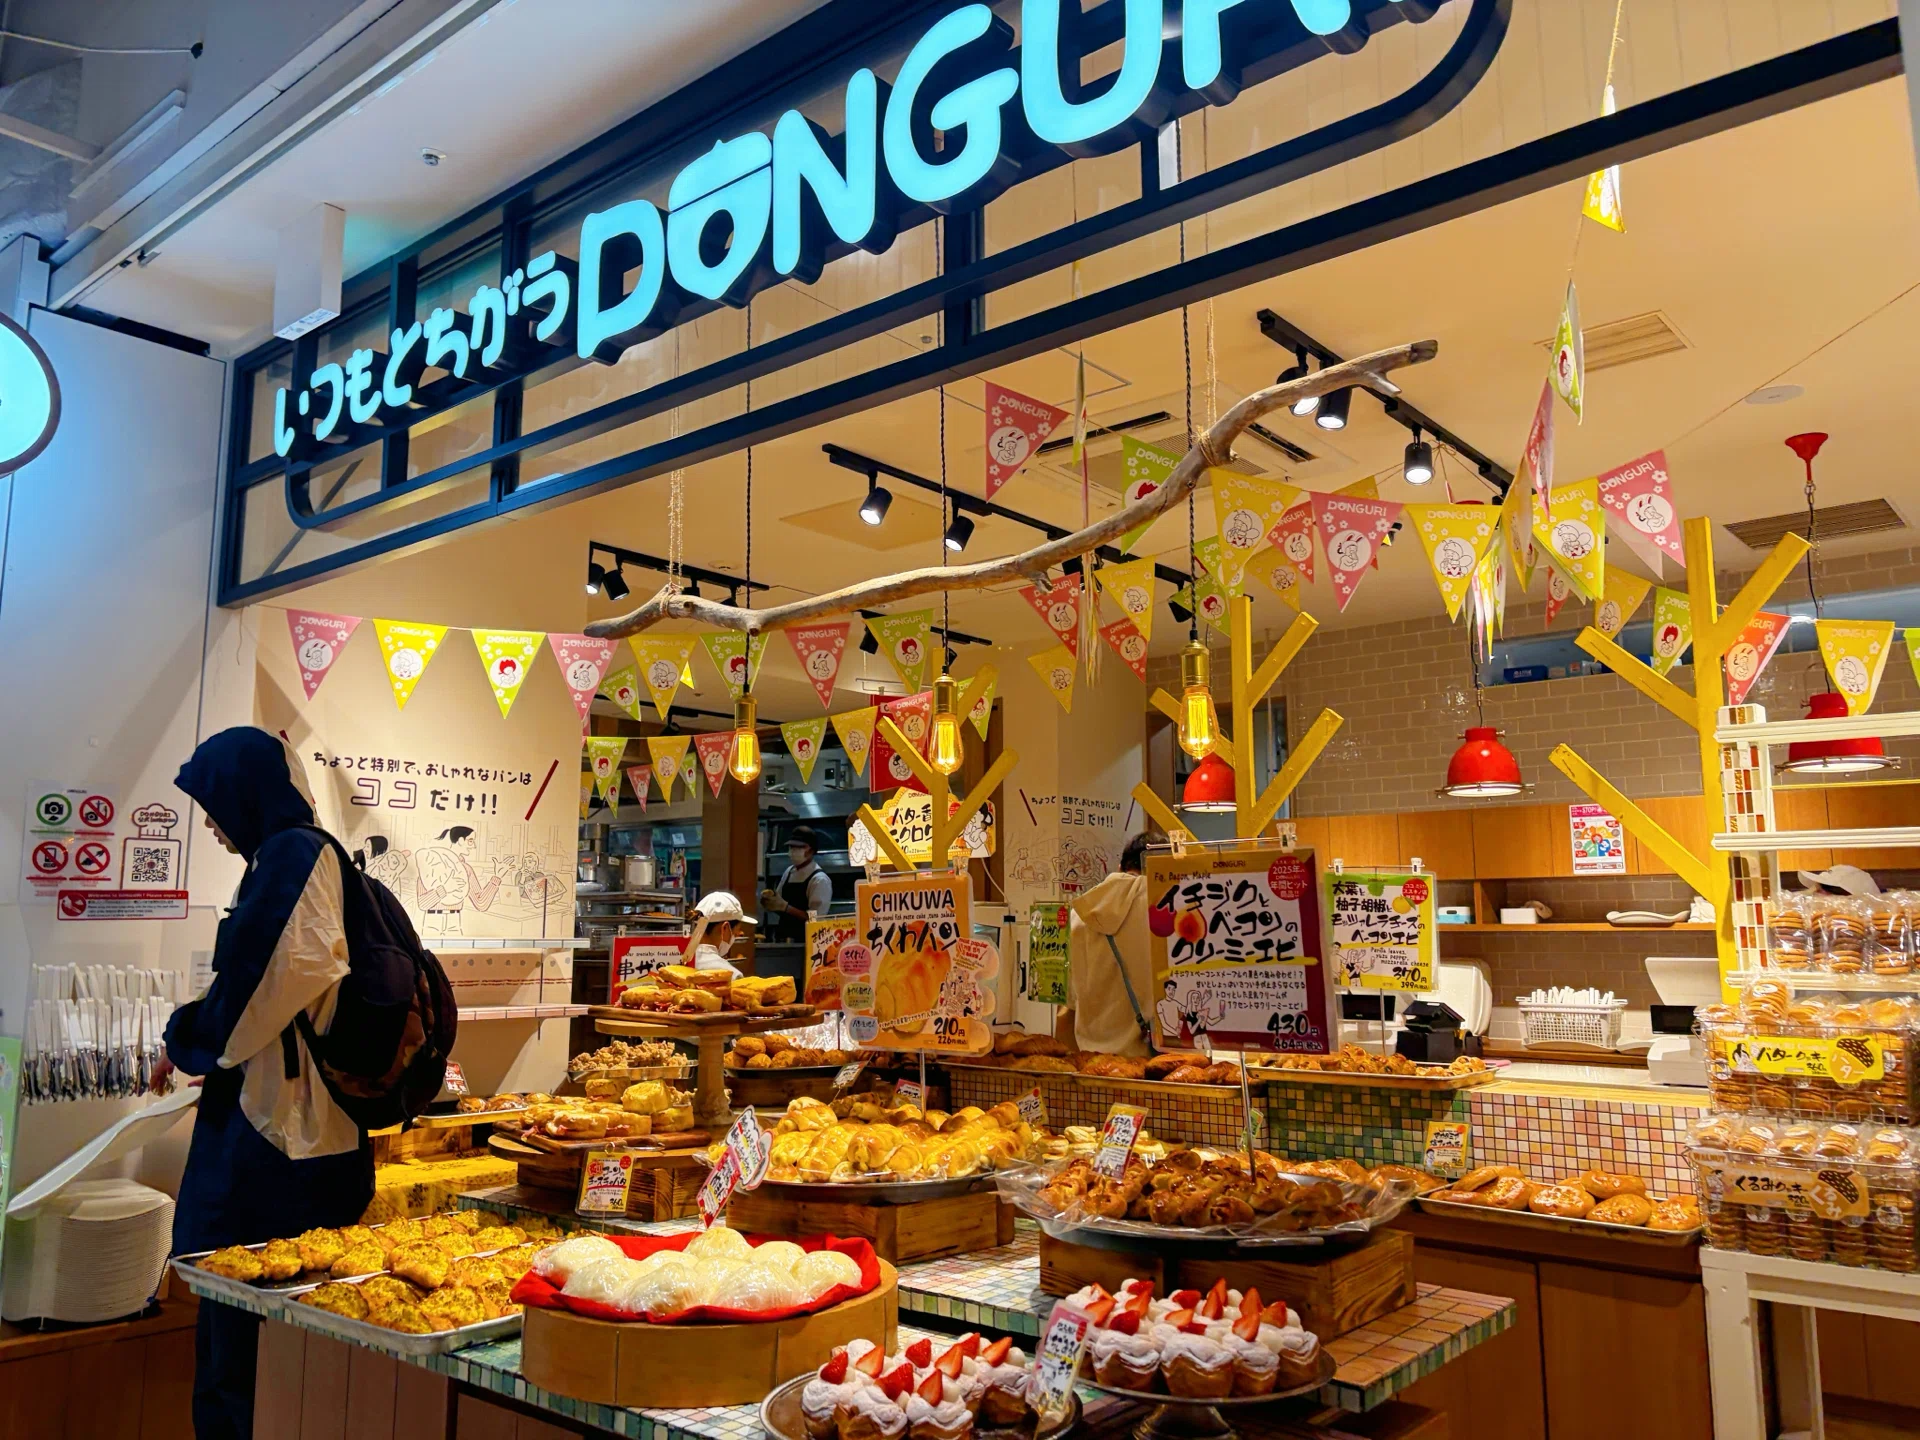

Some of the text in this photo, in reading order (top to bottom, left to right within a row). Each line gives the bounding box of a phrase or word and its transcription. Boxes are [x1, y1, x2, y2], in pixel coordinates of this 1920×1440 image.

[274, 0, 1408, 457] いつもとちがう DONGU
[998, 394, 1053, 420] DONGURI
[1135, 446, 1181, 470] DONGU
[1599, 461, 1656, 492] DONGURI
[1328, 501, 1387, 516] DONGURI
[1533, 489, 1586, 511] DNGURI
[1427, 510, 1487, 520] DONGURI
[1034, 580, 1073, 597] DGURI
[300, 616, 347, 629] DONGURI
[884, 615, 925, 628] DONGURI
[1747, 618, 1774, 630] NGURI
[389, 625, 435, 637] DONGURI
[798, 629, 840, 639] DONGURI
[1831, 628, 1879, 638] DONGURI
[486, 635, 533, 645] DONGURI
[563, 639, 608, 648] DONGURI
[897, 697, 927, 709] DONGURI
[314, 752, 532, 785] ちょっと特別で、おしゃれなパンは
[351, 777, 418, 809] ココ
[1061, 808, 1085, 825] ココ
[1213, 860, 1246, 868] DONGURI
[1156, 879, 1270, 912] イチジクと
[1332, 880, 1365, 896] 大葉と
[871, 889, 955, 912] CHIKUWA
[1335, 897, 1393, 913] 柚子胡椒と
[1209, 910, 1298, 936] ベーコンの
[1331, 913, 1425, 929] モッツァレラチーズの
[866, 921, 960, 956] ちくわパン
[1171, 935, 1298, 965] クリーミーエピ
[1392, 967, 1427, 983] 370円
[933, 1017, 966, 1037] 210円
[1267, 1012, 1319, 1037] 430円
[1735, 1175, 1809, 1192] くるみクッキー
